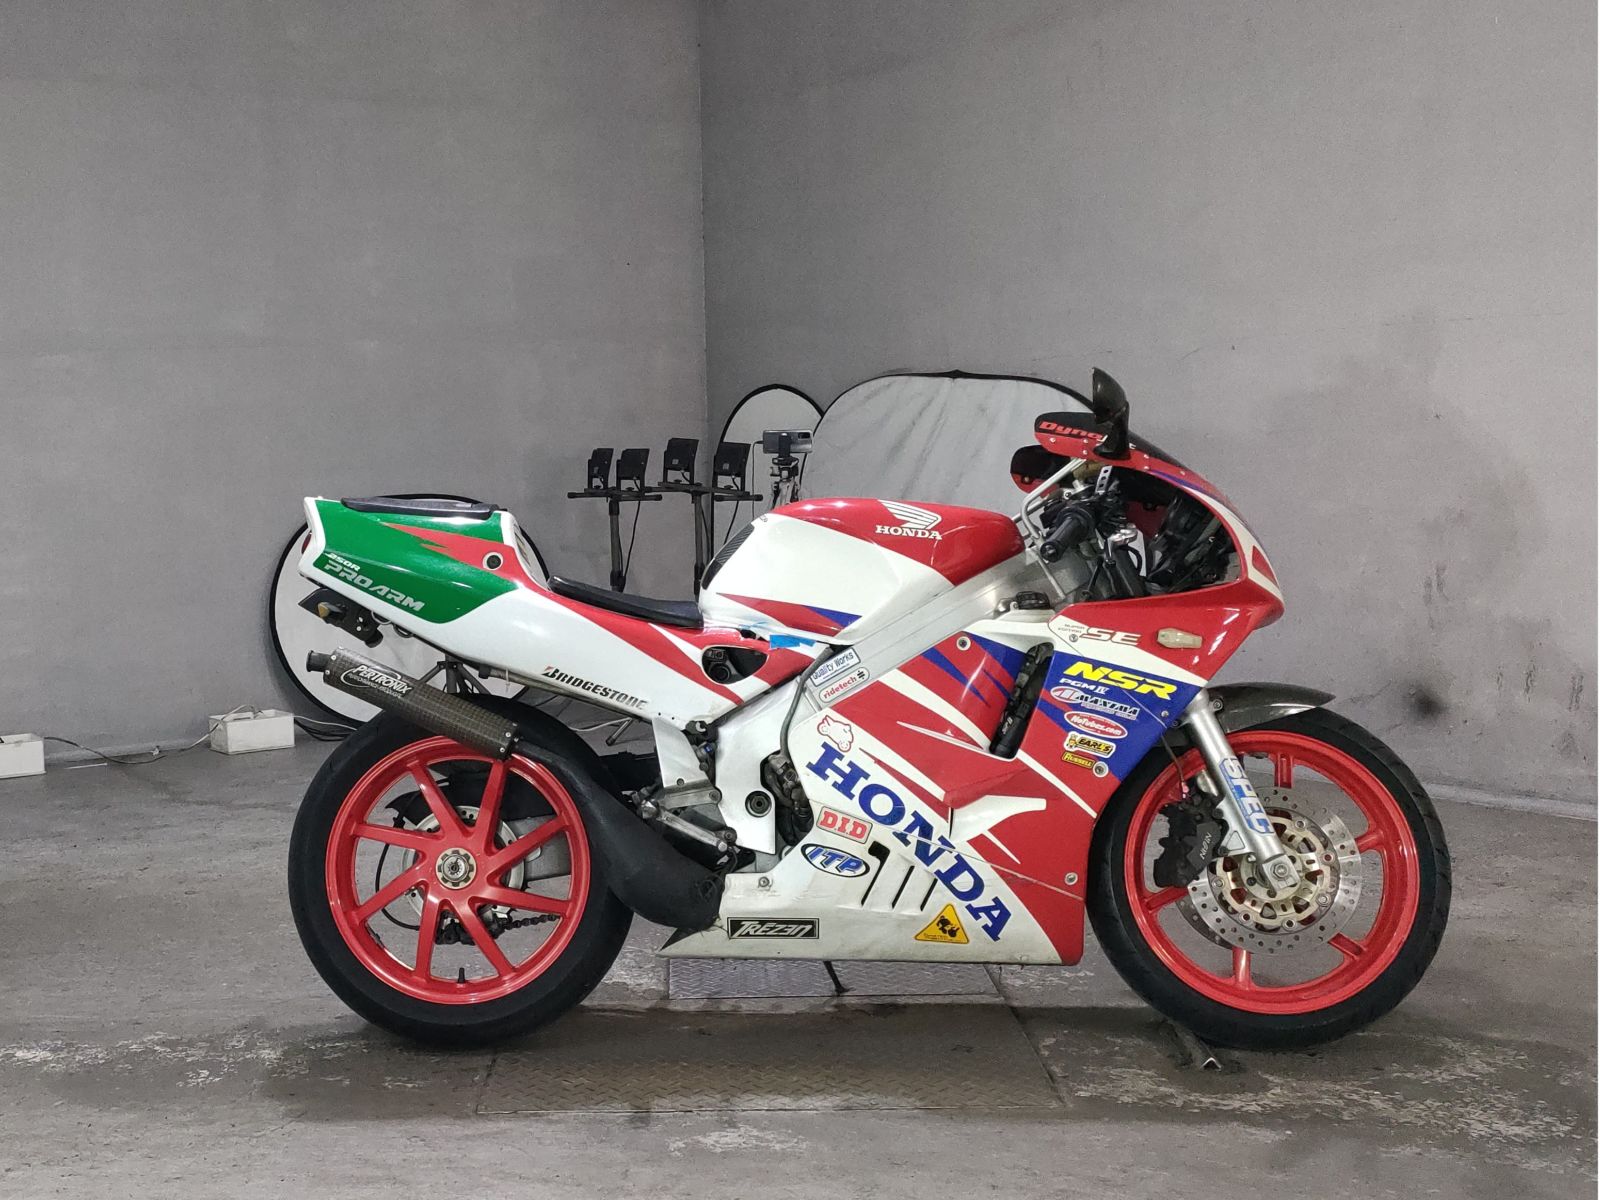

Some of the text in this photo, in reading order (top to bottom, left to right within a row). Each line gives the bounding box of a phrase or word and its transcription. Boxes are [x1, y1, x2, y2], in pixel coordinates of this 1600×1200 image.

[875, 525, 942, 540] HONDA
[324, 553, 361, 571] 250R
[1079, 627, 1142, 646] SE
[541, 666, 648, 710] BRIDGESTONE
[823, 676, 857, 699] ridetech
[1059, 678, 1097, 693] PGM
[1063, 661, 1177, 700] NSR
[1076, 693, 1140, 716] MAXIMA
[1224, 759, 1275, 833] SPEC
[806, 741, 1011, 942] HONDA
[809, 846, 864, 874] ITP
